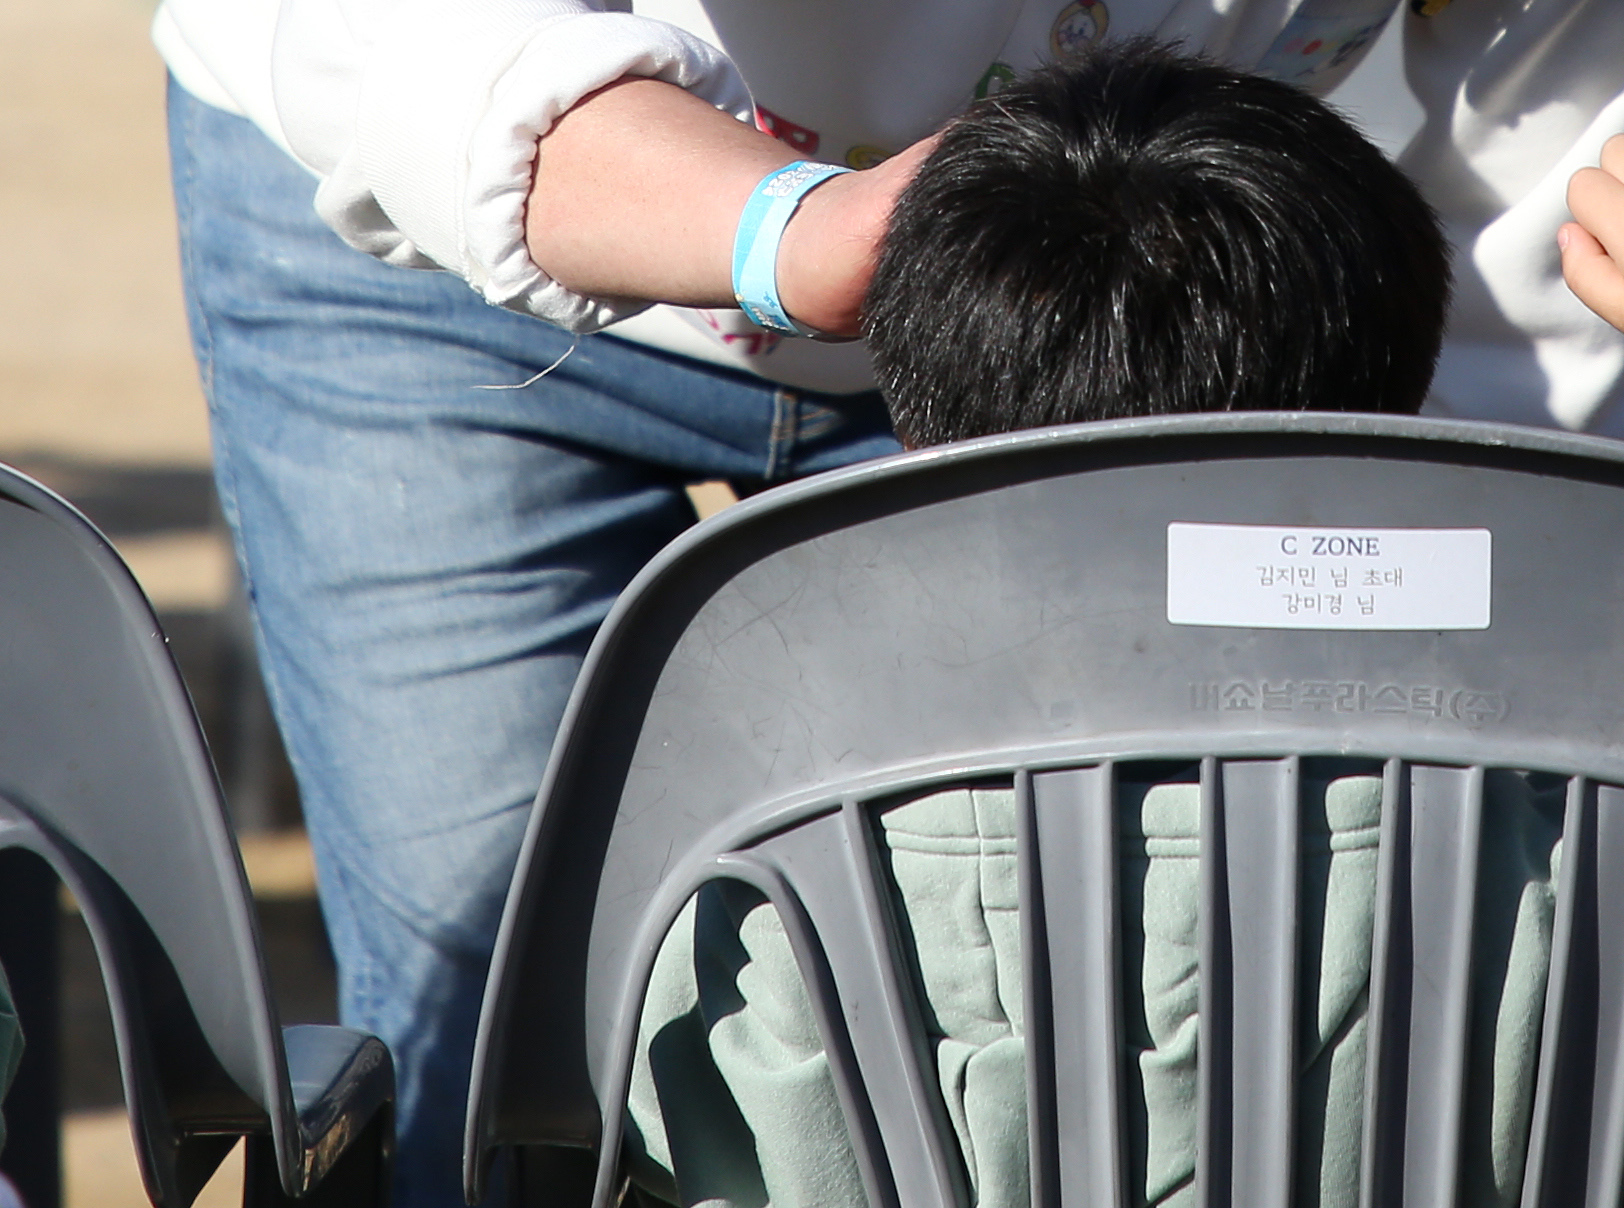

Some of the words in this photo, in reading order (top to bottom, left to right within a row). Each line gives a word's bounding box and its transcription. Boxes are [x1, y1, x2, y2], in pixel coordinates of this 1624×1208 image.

[1281, 535, 1298, 556] C
[1311, 535, 1381, 557] ZONE
[1256, 564, 1316, 588] 김지민
[1331, 566, 1348, 588] 님
[1361, 566, 1403, 588] 초대
[1281, 592, 1342, 616] 강미경
[1357, 594, 1375, 616] 님
